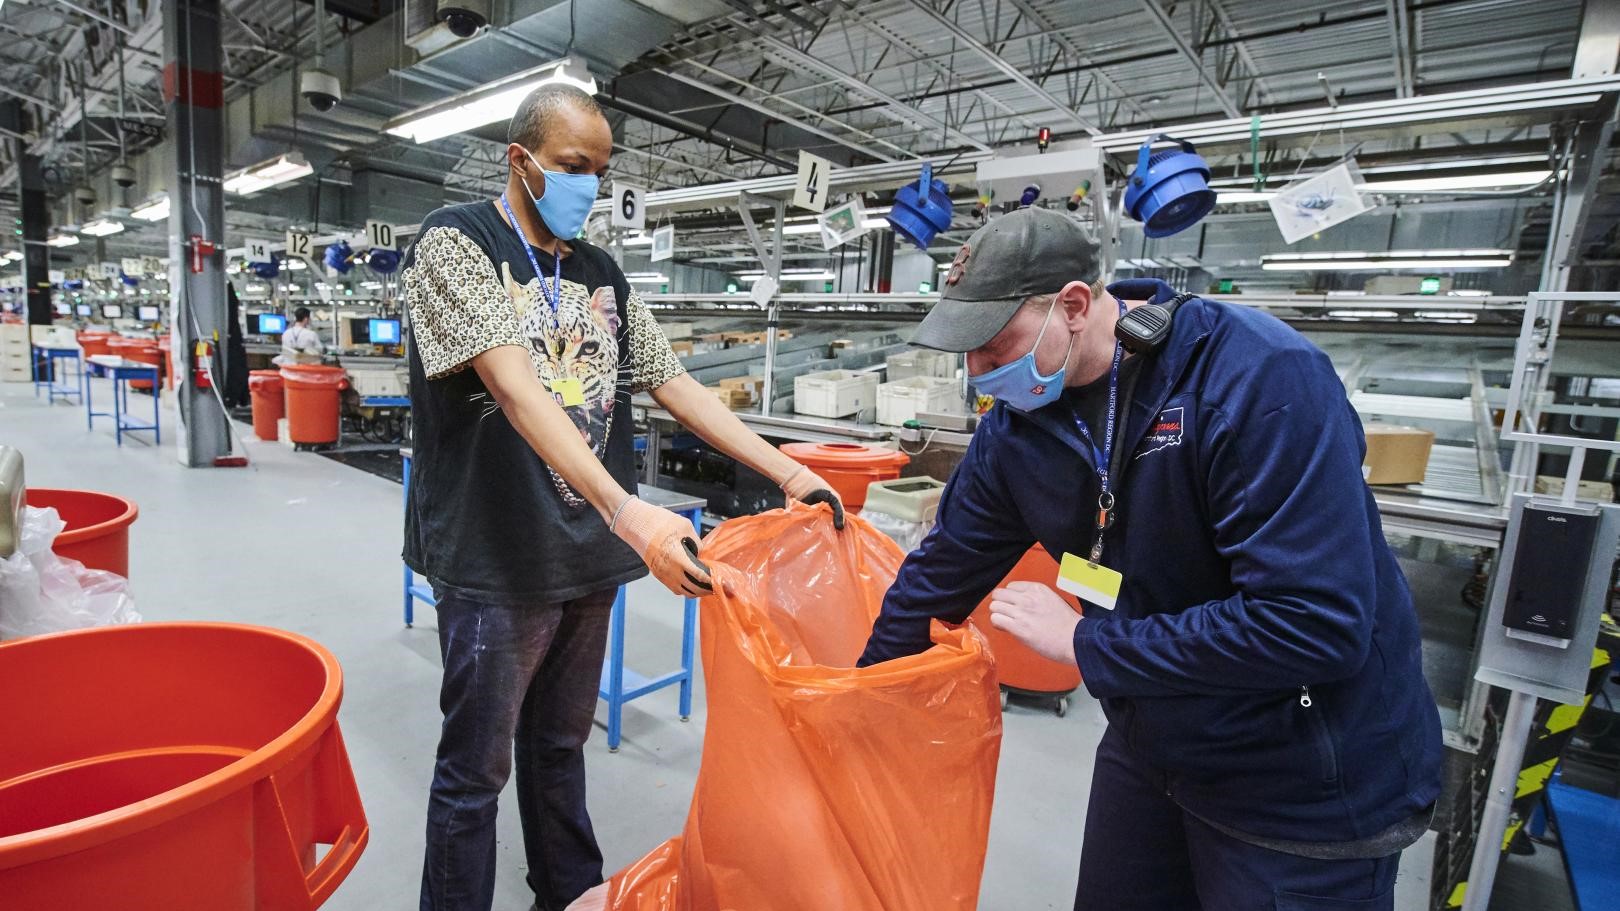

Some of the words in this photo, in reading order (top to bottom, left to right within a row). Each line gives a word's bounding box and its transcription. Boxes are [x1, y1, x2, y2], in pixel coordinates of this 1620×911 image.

[806, 161, 818, 204] 4
[621, 189, 636, 220] 6
[291, 234, 309, 255] 12
[371, 223, 392, 247] 10
[251, 244, 264, 257] 14
[144, 257, 160, 271] 20
[1112, 361, 1119, 372] DC
[1108, 386, 1117, 419] HARTFORD
[1105, 420, 1115, 444] REGION
[1168, 434, 1176, 442] DC
[1104, 443, 1112, 453] DC
